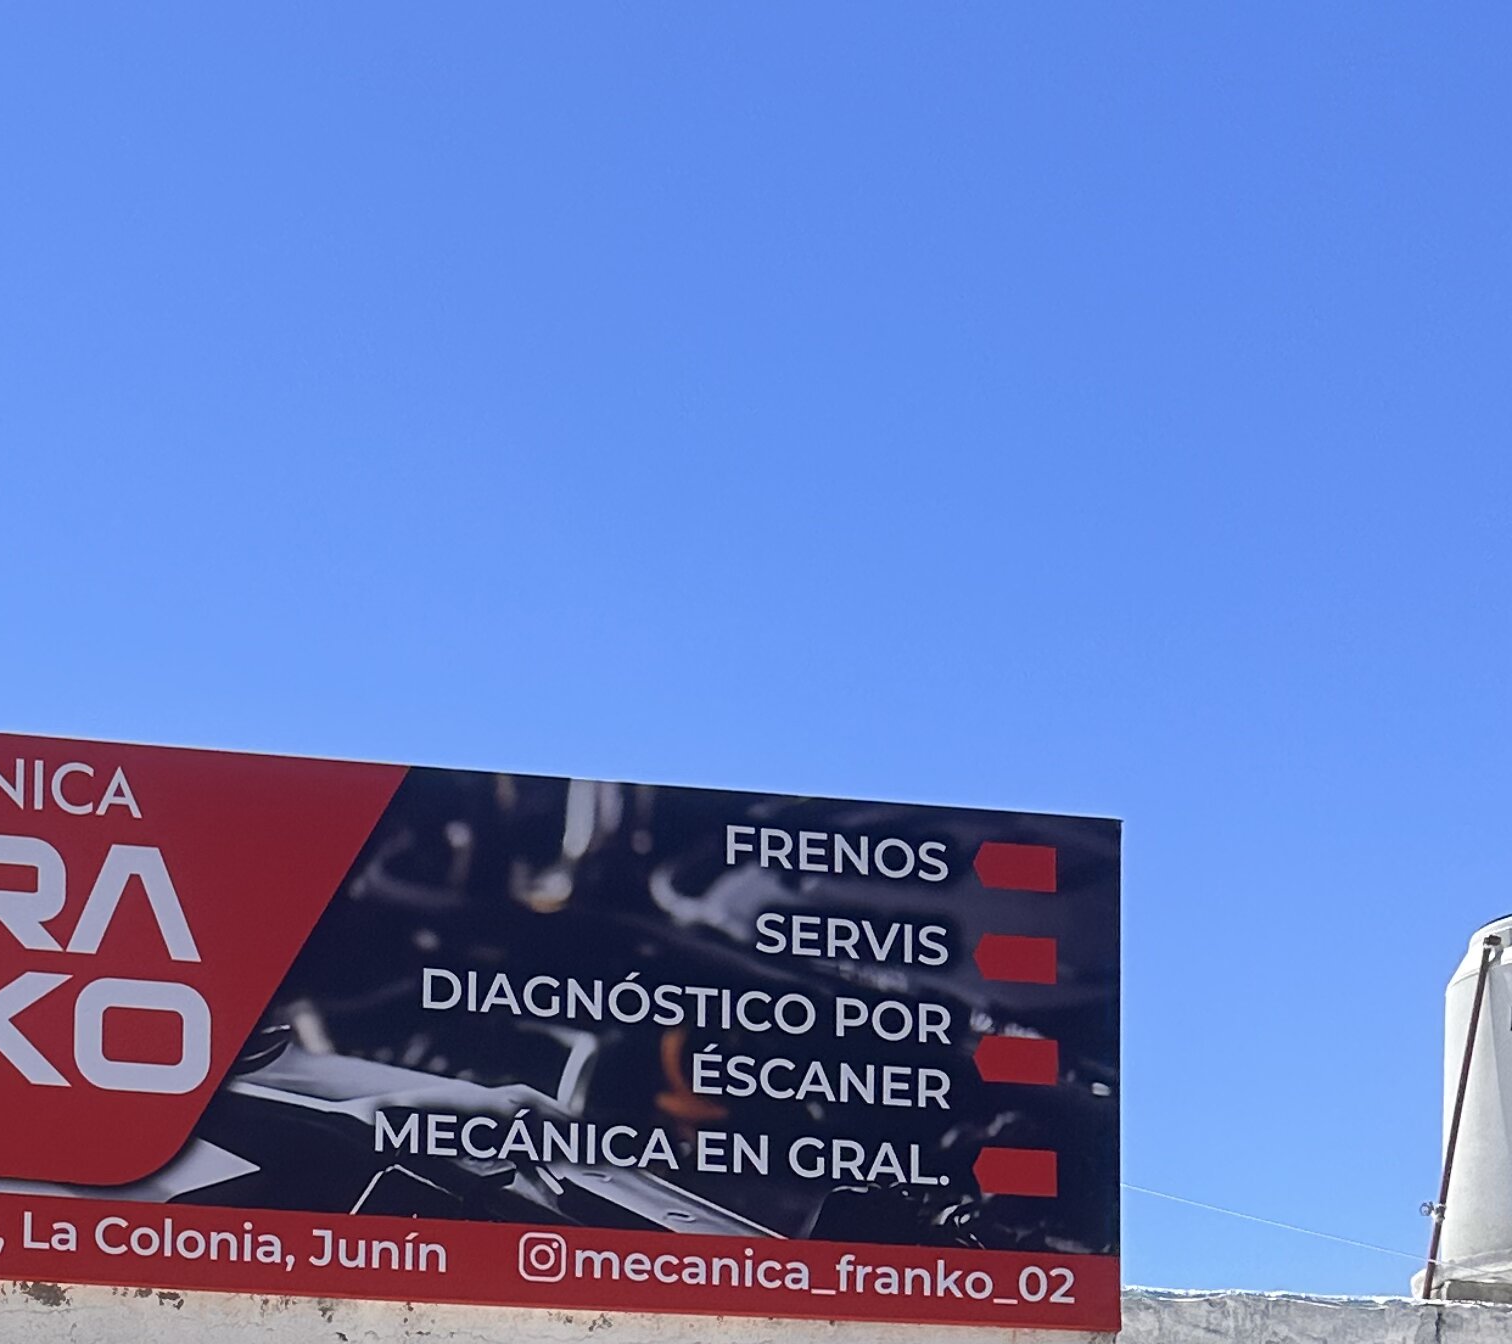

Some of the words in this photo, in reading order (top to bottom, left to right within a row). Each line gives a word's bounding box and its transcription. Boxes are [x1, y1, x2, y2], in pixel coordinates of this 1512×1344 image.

[725, 824, 950, 882] FRENOS
[755, 913, 950, 966] SERVIS
[421, 967, 816, 1037] DIAGNÓSTICO
[834, 998, 952, 1045] POR
[691, 1043, 952, 1110] ÉSCANER
[373, 1109, 678, 1171] MECÁNICA
[696, 1131, 770, 1177] EN
[789, 1136, 951, 1187] GRAL.
[22, 1210, 78, 1252] La
[93, 1216, 296, 1273] Colonia,
[308, 1229, 448, 1275] Junín
[574, 1248, 1076, 1306] mecanica_franko_02
